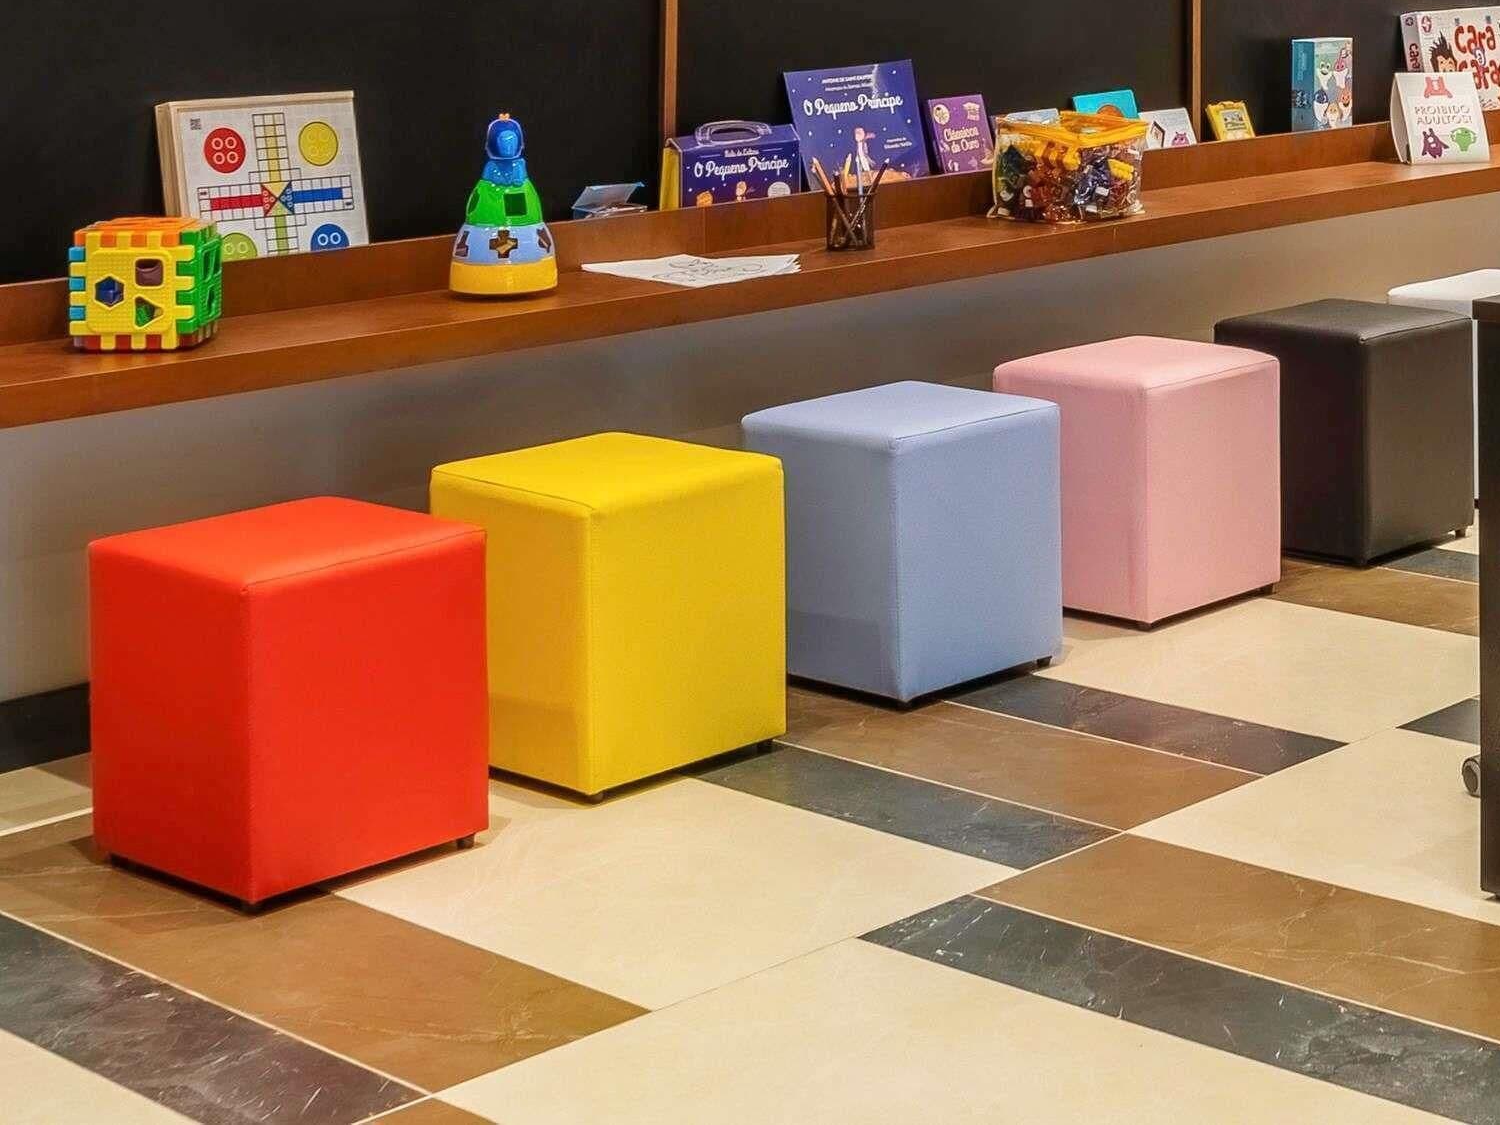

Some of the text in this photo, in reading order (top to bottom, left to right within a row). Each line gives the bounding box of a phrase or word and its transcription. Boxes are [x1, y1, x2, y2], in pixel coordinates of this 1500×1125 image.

[803, 92, 904, 120] O Pequeno Príncipe
[694, 156, 790, 182] O Pequeno Príncipe
